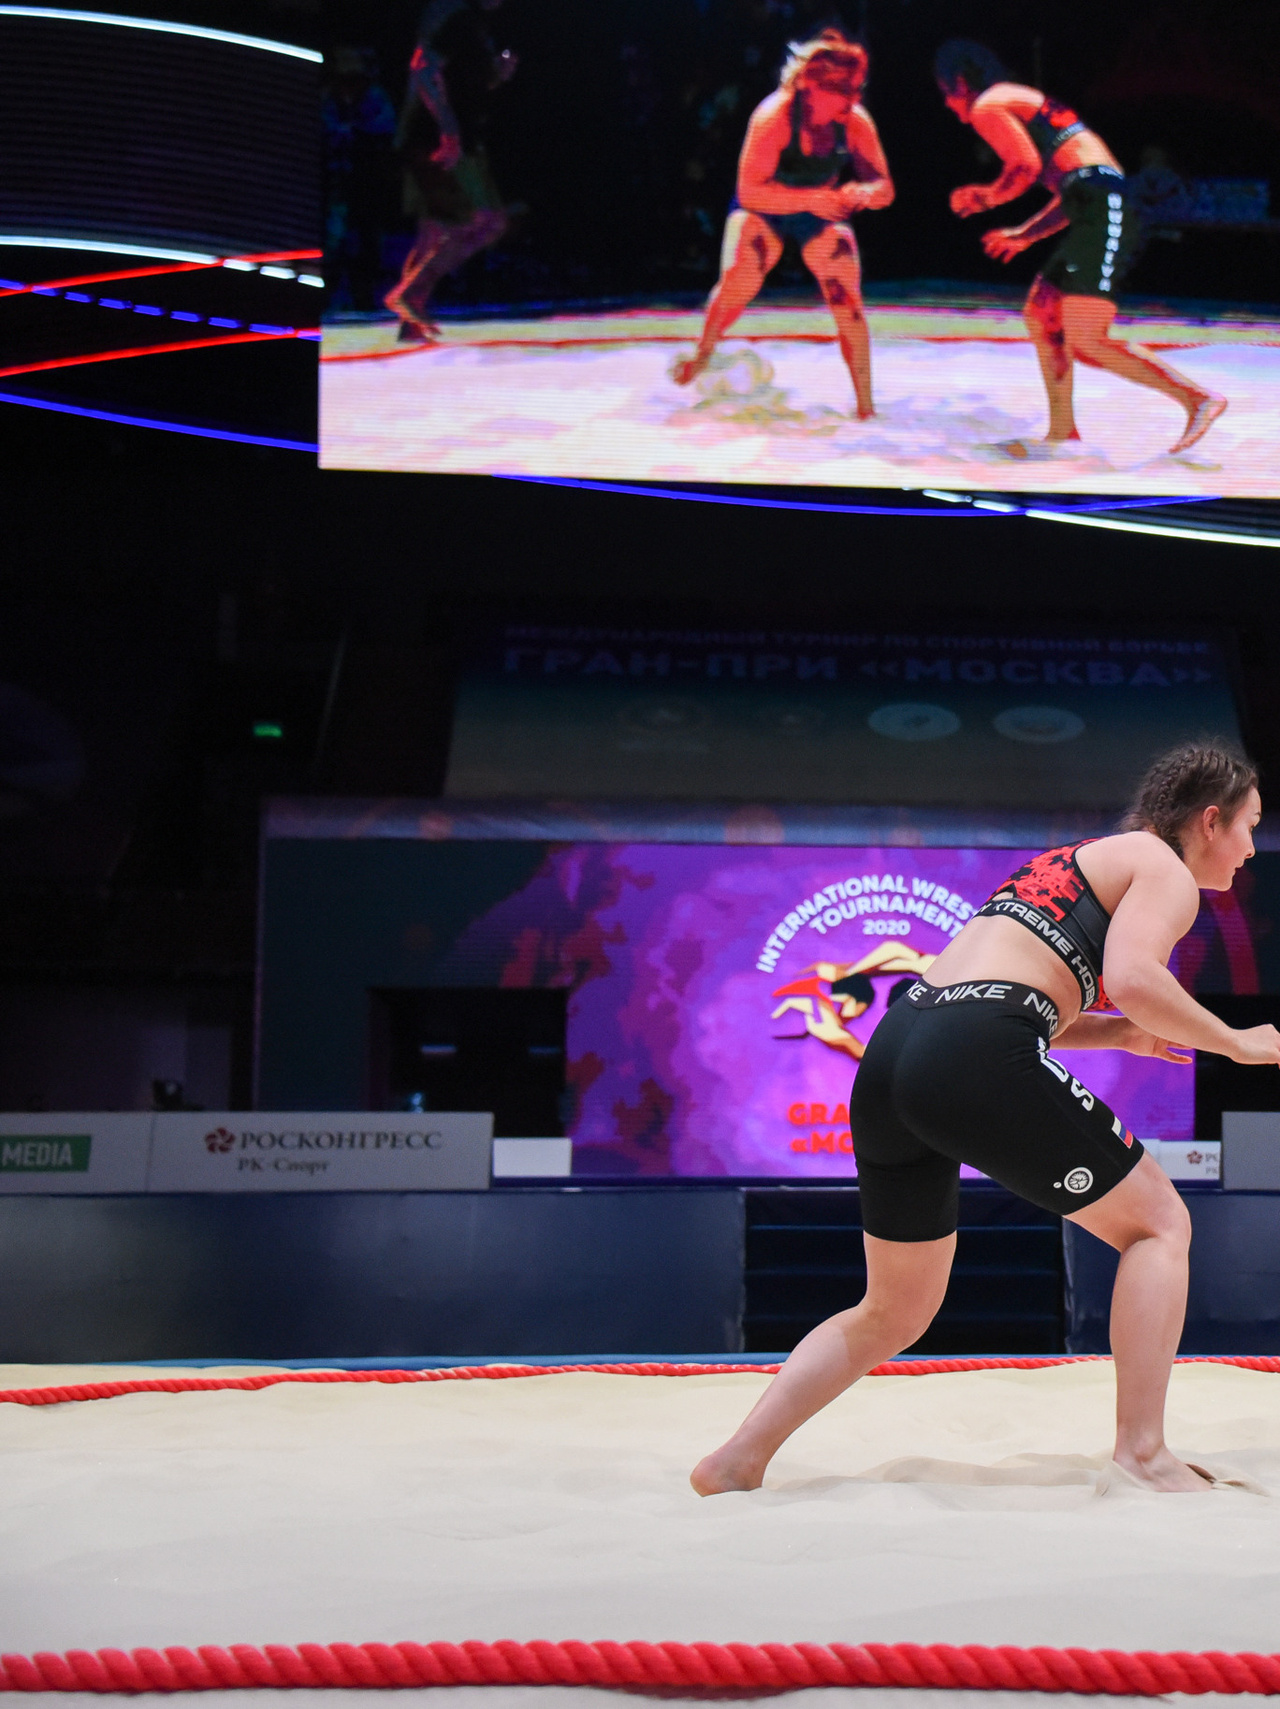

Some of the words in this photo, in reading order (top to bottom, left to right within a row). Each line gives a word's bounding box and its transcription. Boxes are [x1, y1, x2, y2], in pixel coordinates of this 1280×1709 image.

[503, 648, 838, 681] ГРАН-ПРИ
[858, 656, 1212, 687] «МОСКВА»
[756, 874, 909, 974] INTERNATIONAL
[808, 894, 965, 939] TOURNAMENT
[862, 919, 911, 936] 2020
[1070, 954, 1096, 1011] HOBB
[906, 981, 928, 1002] KE
[934, 984, 1013, 1004] NIKE
[1023, 992, 1059, 1037] NIKE
[787, 1102, 851, 1126] GRA
[2, 1142, 73, 1167] MEDIA
[240, 1130, 443, 1151] РОСКОНГРЕСС
